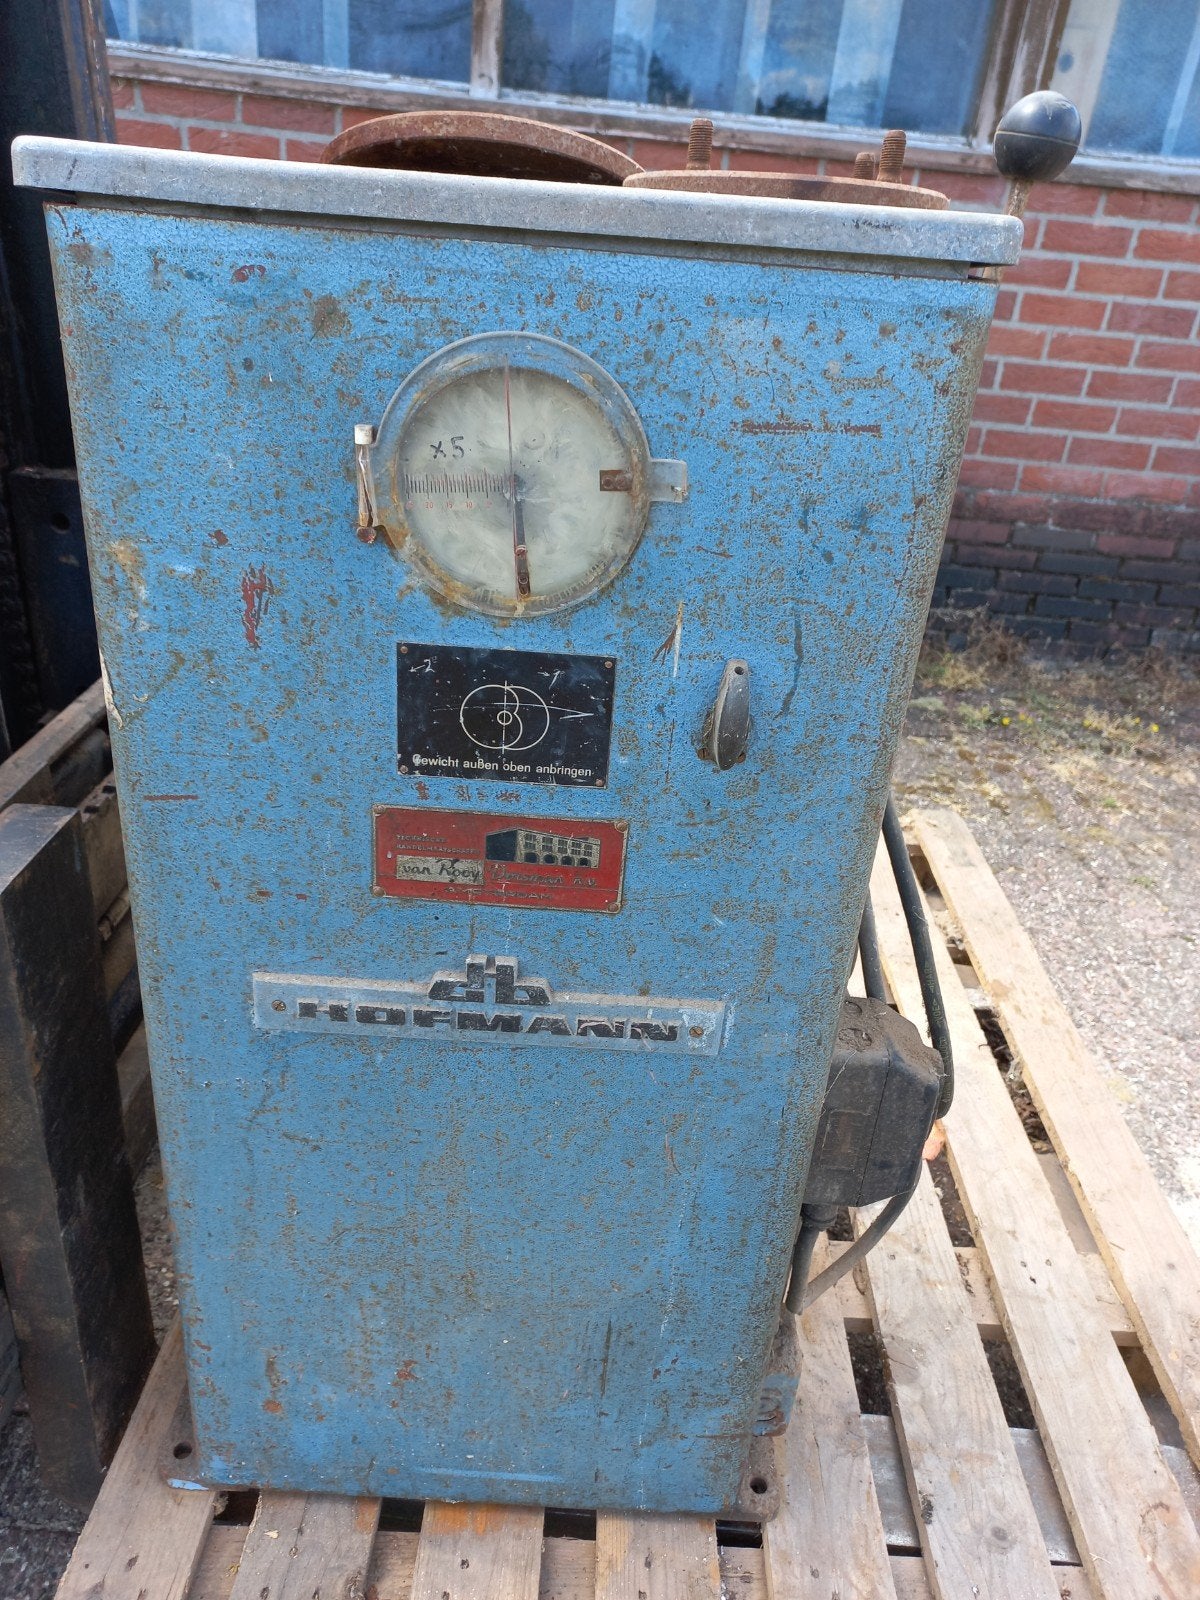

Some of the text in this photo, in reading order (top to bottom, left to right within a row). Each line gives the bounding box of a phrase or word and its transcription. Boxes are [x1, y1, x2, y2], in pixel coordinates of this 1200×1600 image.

[412, 753, 592, 778] Gewicht außen oben anbringen
[403, 865, 431, 876] van
[435, 859, 481, 882] Rooy
[298, 1000, 679, 1042] HOFMANN
